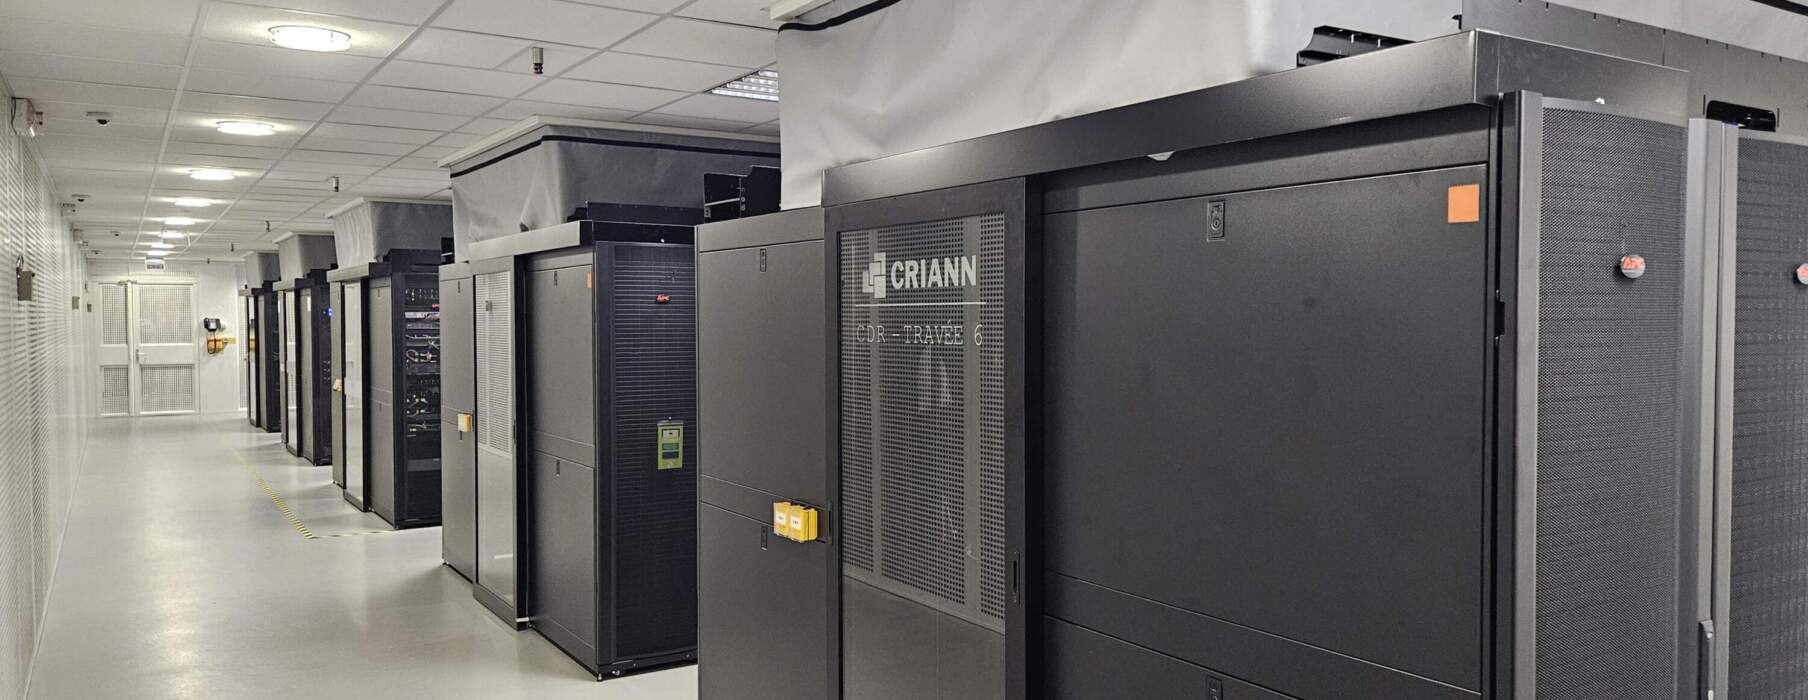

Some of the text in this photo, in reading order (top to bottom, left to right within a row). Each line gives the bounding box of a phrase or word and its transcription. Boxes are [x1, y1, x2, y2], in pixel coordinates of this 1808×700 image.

[891, 255, 977, 290] CRIANN
[856, 324, 886, 343] CDR
[903, 319, 963, 345] TRAVÉE
[974, 324, 983, 346] 6
